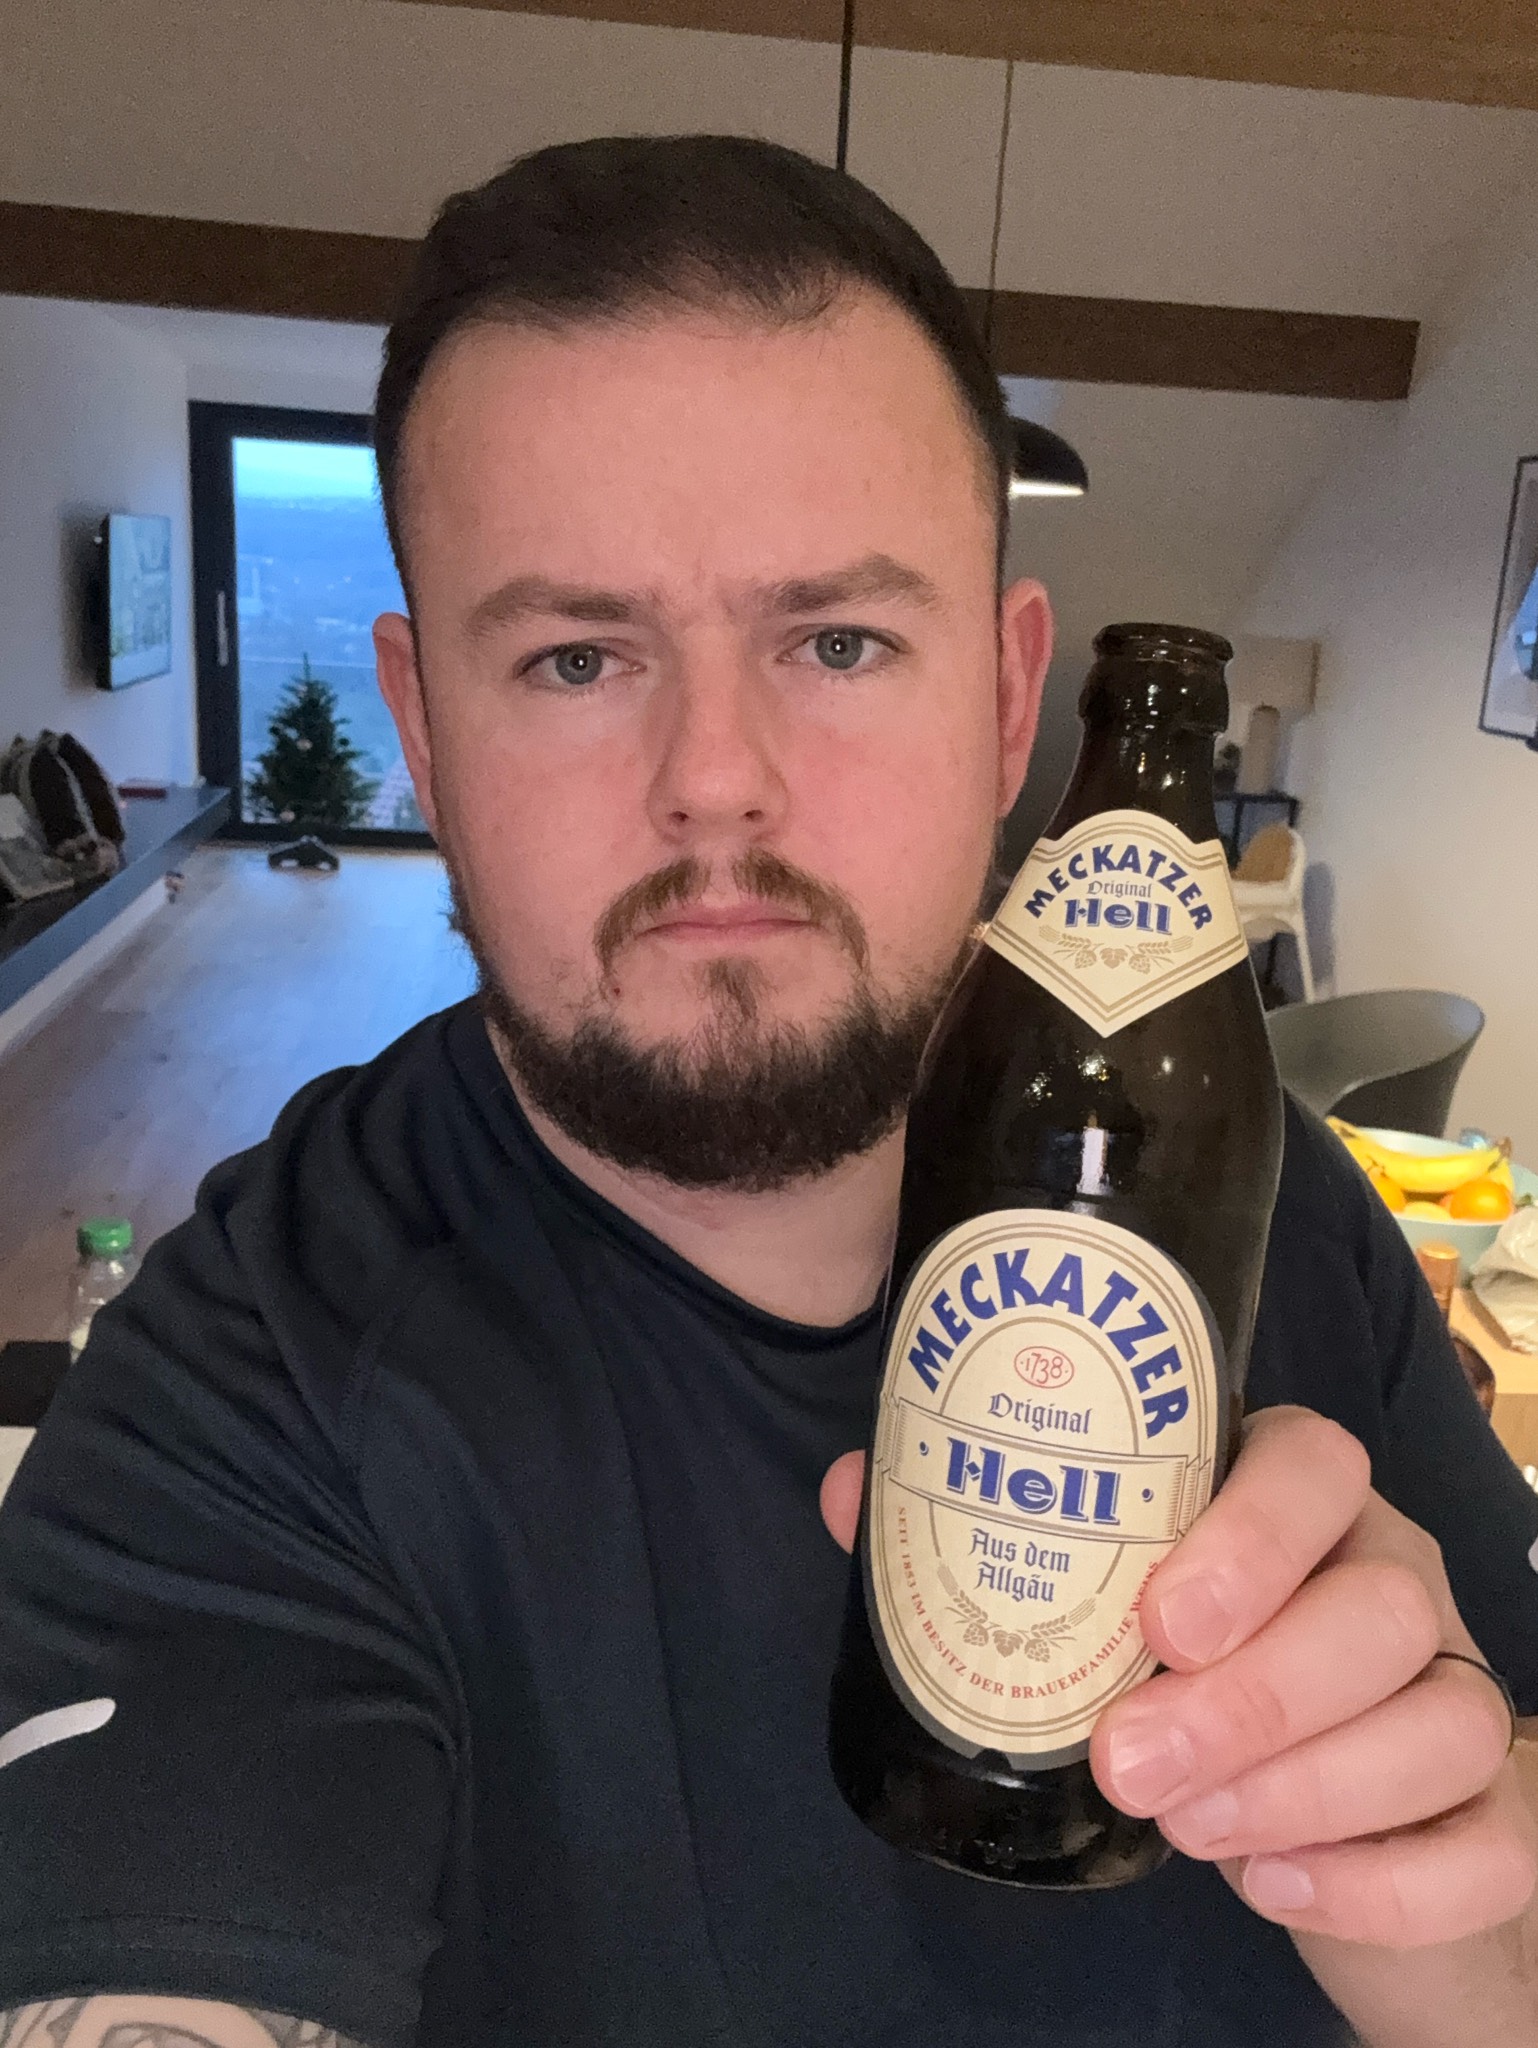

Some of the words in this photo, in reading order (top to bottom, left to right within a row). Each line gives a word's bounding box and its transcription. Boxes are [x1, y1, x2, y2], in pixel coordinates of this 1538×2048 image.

[1024, 844, 1213, 930] MECKATZER
[1087, 880, 1152, 899] Original
[1065, 898, 1172, 936] Hell
[908, 1247, 1190, 1439] MECKATZER
[1026, 1352, 1064, 1384] 1738
[988, 1392, 1093, 1435] Original
[947, 1436, 1121, 1526] Hell
[898, 1506, 908, 1545] SEIT
[902, 1553, 917, 1588] 1853
[968, 1527, 1017, 1561] Aus
[1024, 1541, 1071, 1573] dem
[973, 1561, 1056, 1603] Allgäu
[911, 1592, 926, 1616] IM
[922, 1619, 967, 1677] BESITZ
[1011, 1616, 1134, 1700] BRAUERFAMILIE
[969, 1672, 1005, 1697] DER
